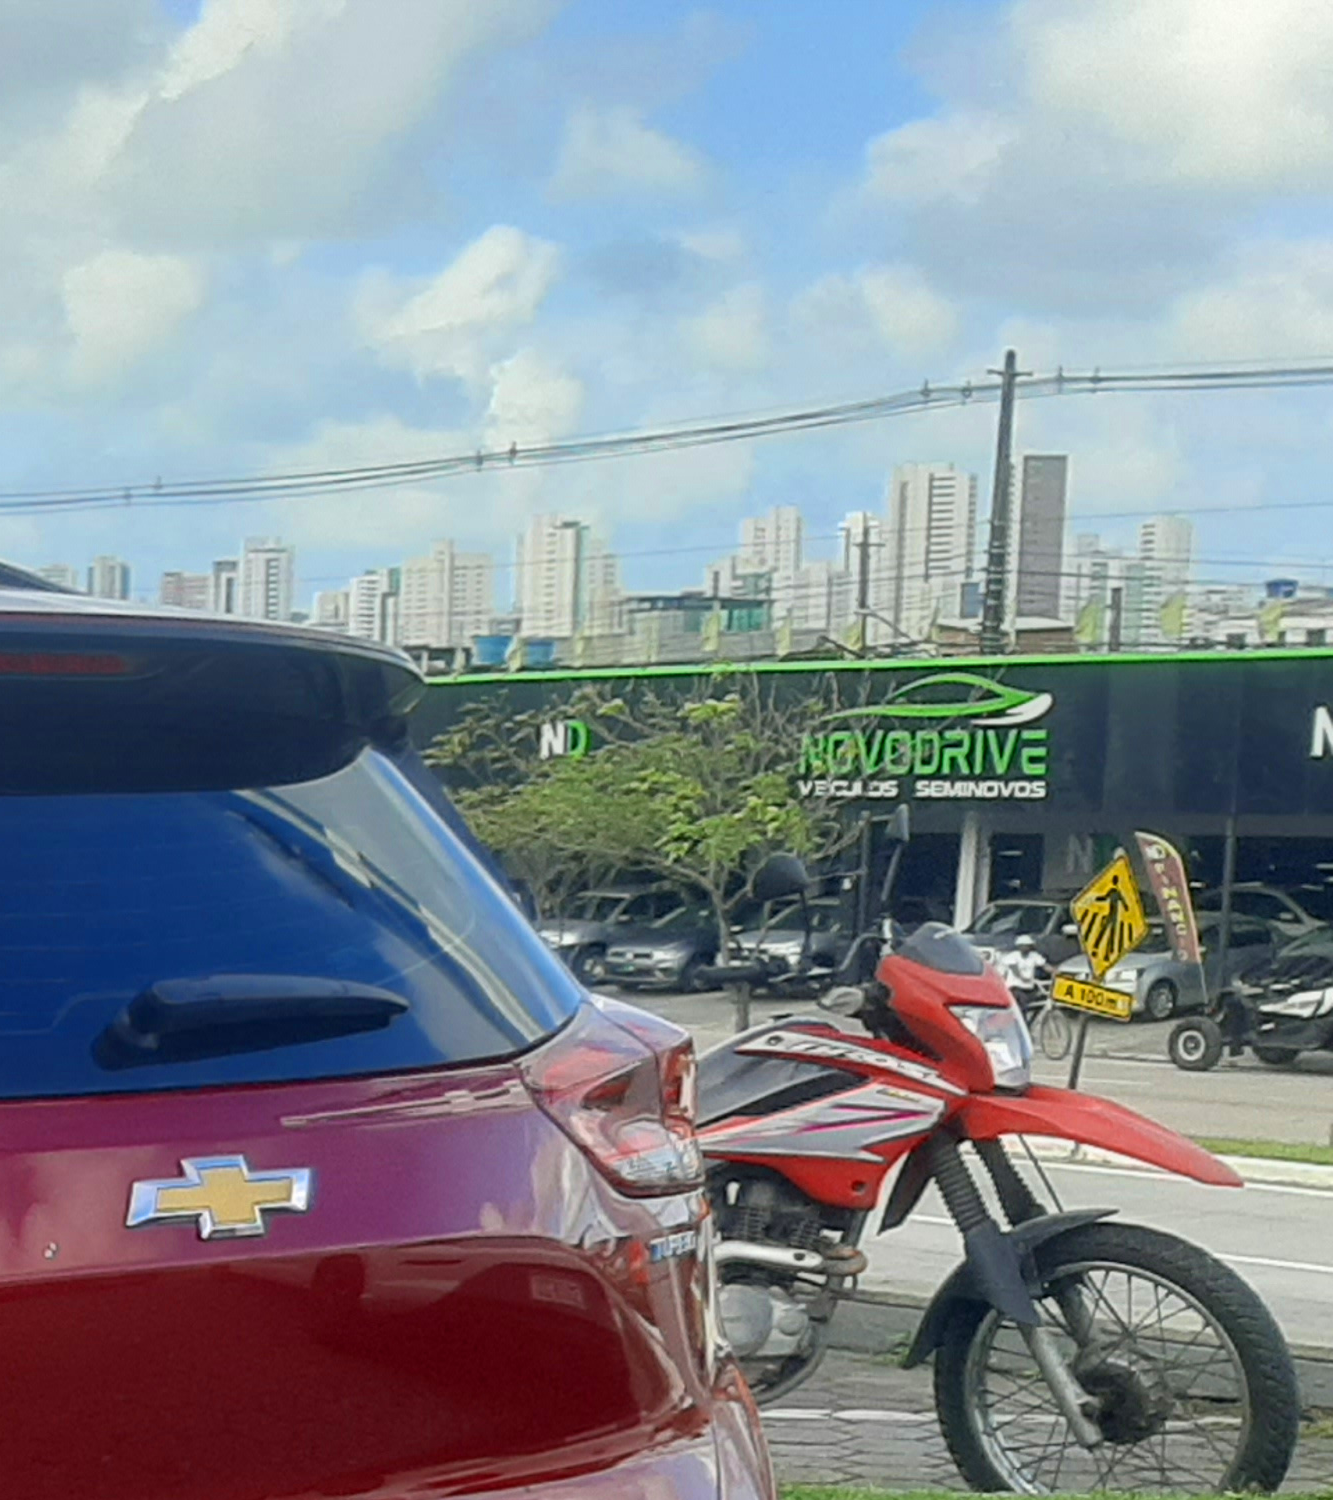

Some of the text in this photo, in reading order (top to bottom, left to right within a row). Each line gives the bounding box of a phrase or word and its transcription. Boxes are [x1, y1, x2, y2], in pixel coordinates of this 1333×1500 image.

[540, 719, 590, 760] ND
[799, 728, 1049, 777] NOVODRIVE
[914, 779, 1048, 799] SEMINOVOS
[1064, 983, 1075, 1000] A
